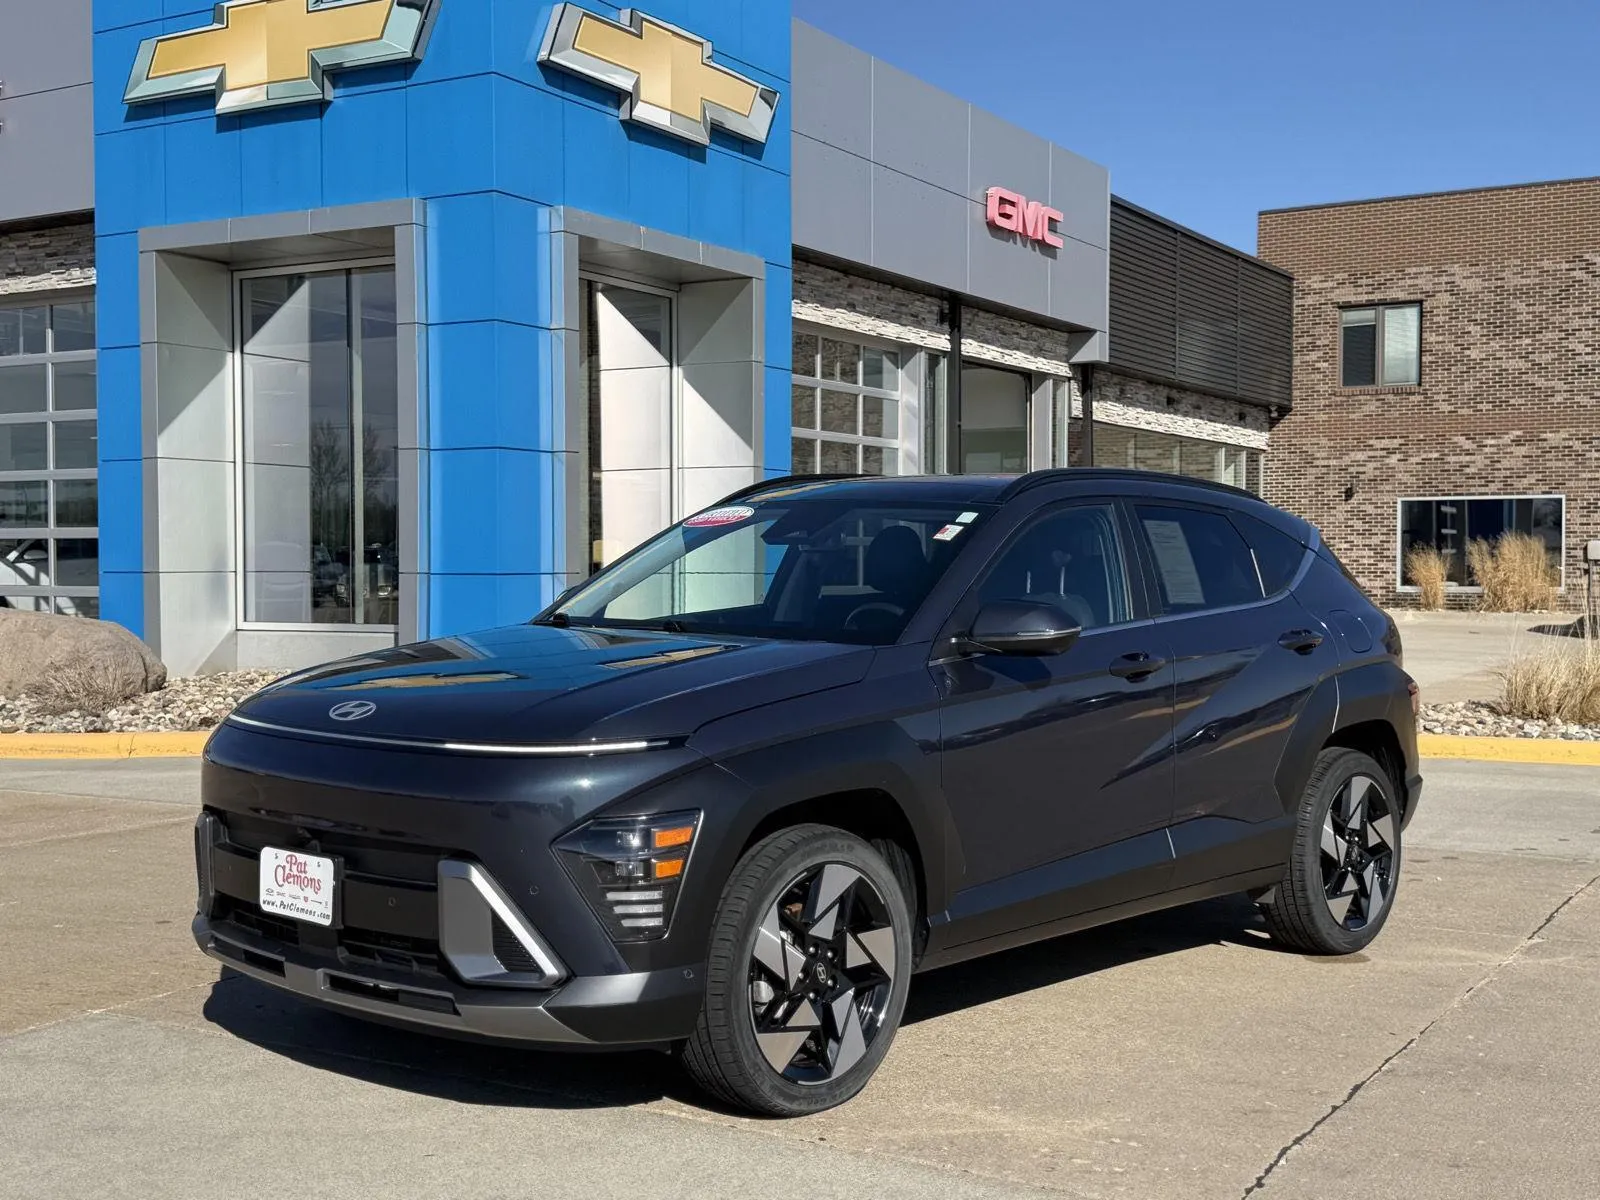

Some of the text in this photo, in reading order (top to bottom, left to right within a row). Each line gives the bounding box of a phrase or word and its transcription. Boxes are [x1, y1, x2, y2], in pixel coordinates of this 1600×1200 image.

[985, 186, 1064, 249] GMC
[274, 864, 322, 895] Clemons
[285, 854, 308, 874] Pat
